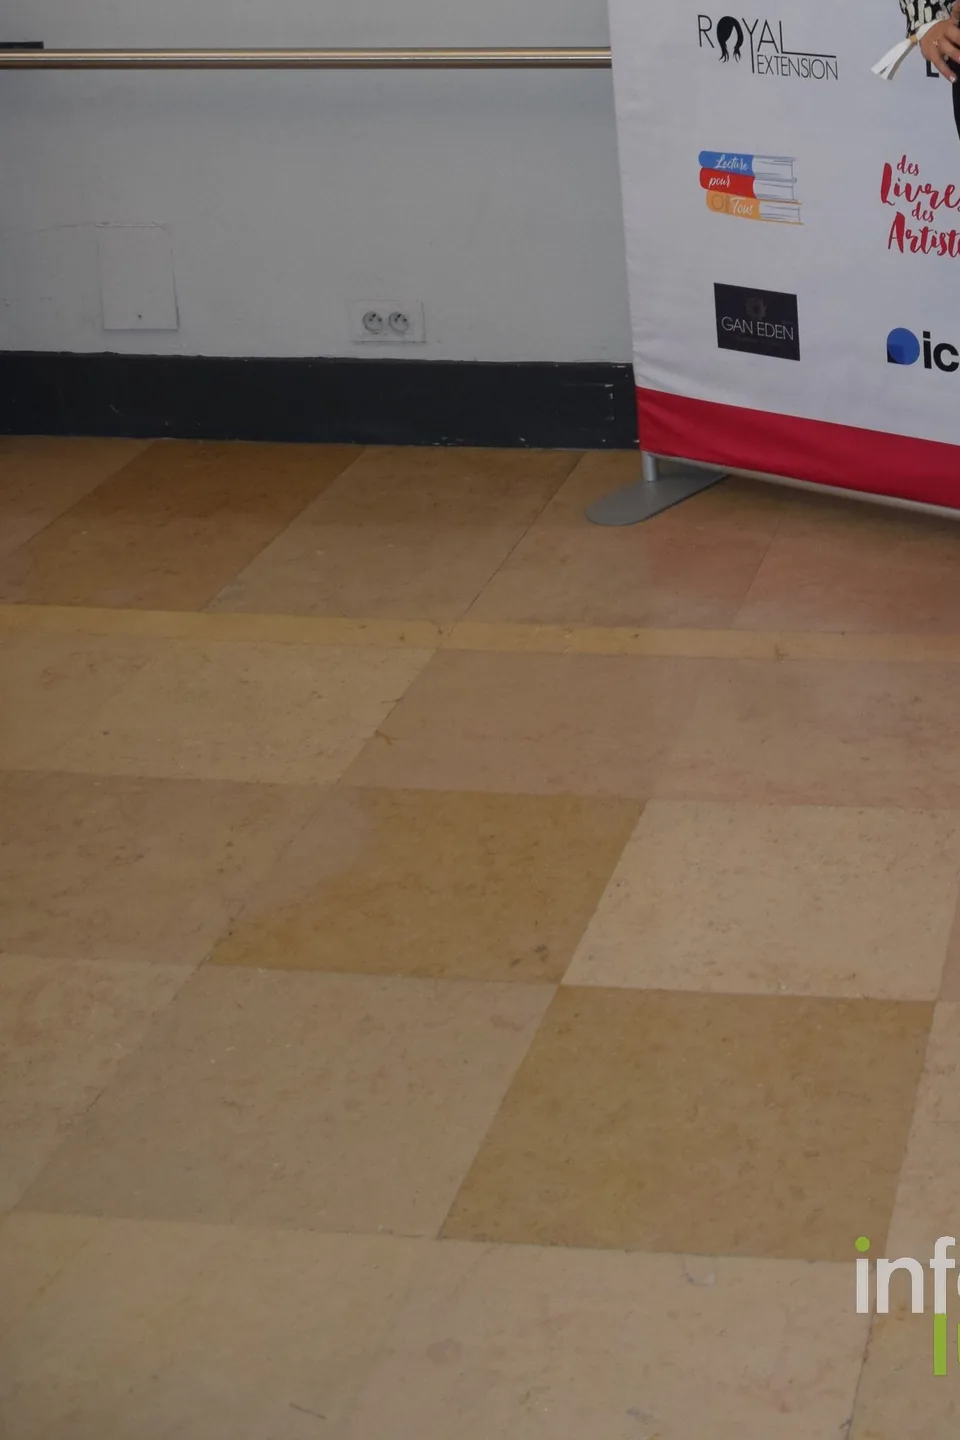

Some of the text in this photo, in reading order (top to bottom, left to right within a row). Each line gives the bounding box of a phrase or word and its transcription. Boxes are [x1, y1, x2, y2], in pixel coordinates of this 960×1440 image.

[757, 54, 839, 81] EXTENSION
[715, 153, 749, 172] Lecture
[897, 155, 919, 176] des
[708, 174, 732, 188] pour
[729, 197, 754, 216] Tous
[912, 201, 933, 222] des
[721, 316, 794, 341] GAN EDEN
